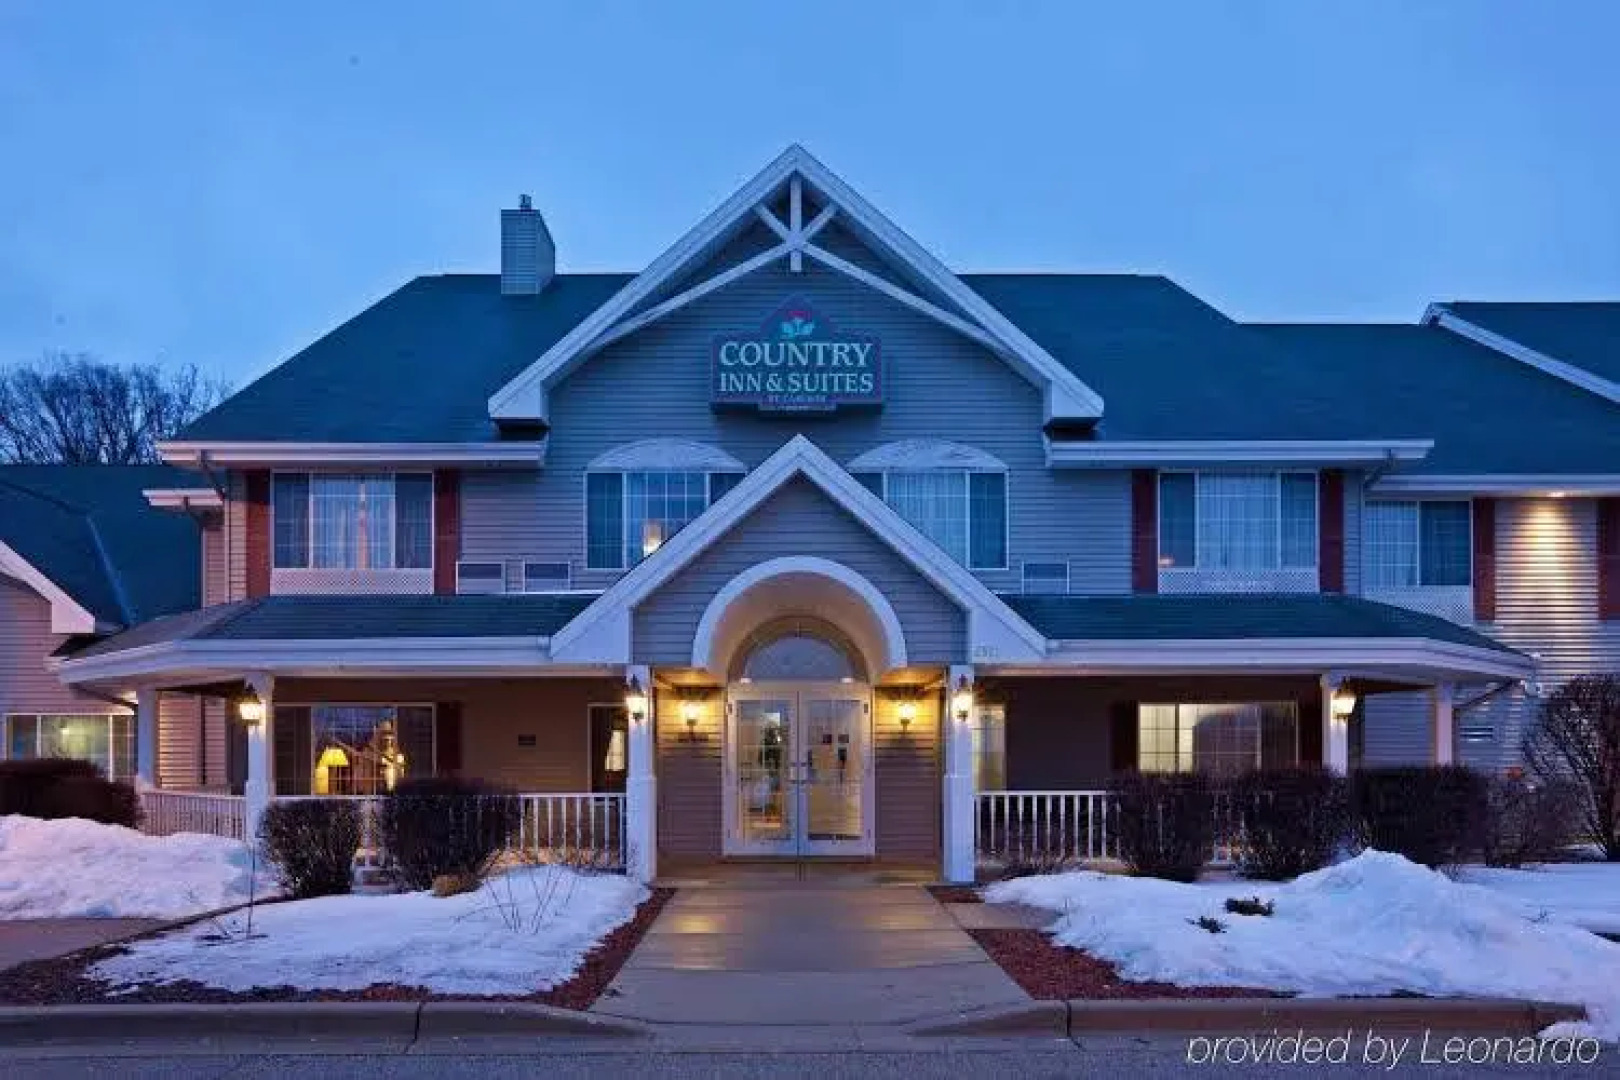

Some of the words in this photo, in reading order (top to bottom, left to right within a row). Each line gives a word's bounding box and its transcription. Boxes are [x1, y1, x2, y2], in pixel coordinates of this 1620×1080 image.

[719, 341, 873, 367] COUNTRY
[718, 373, 761, 392] INN
[766, 373, 785, 392] &
[787, 373, 874, 393] SUITES
